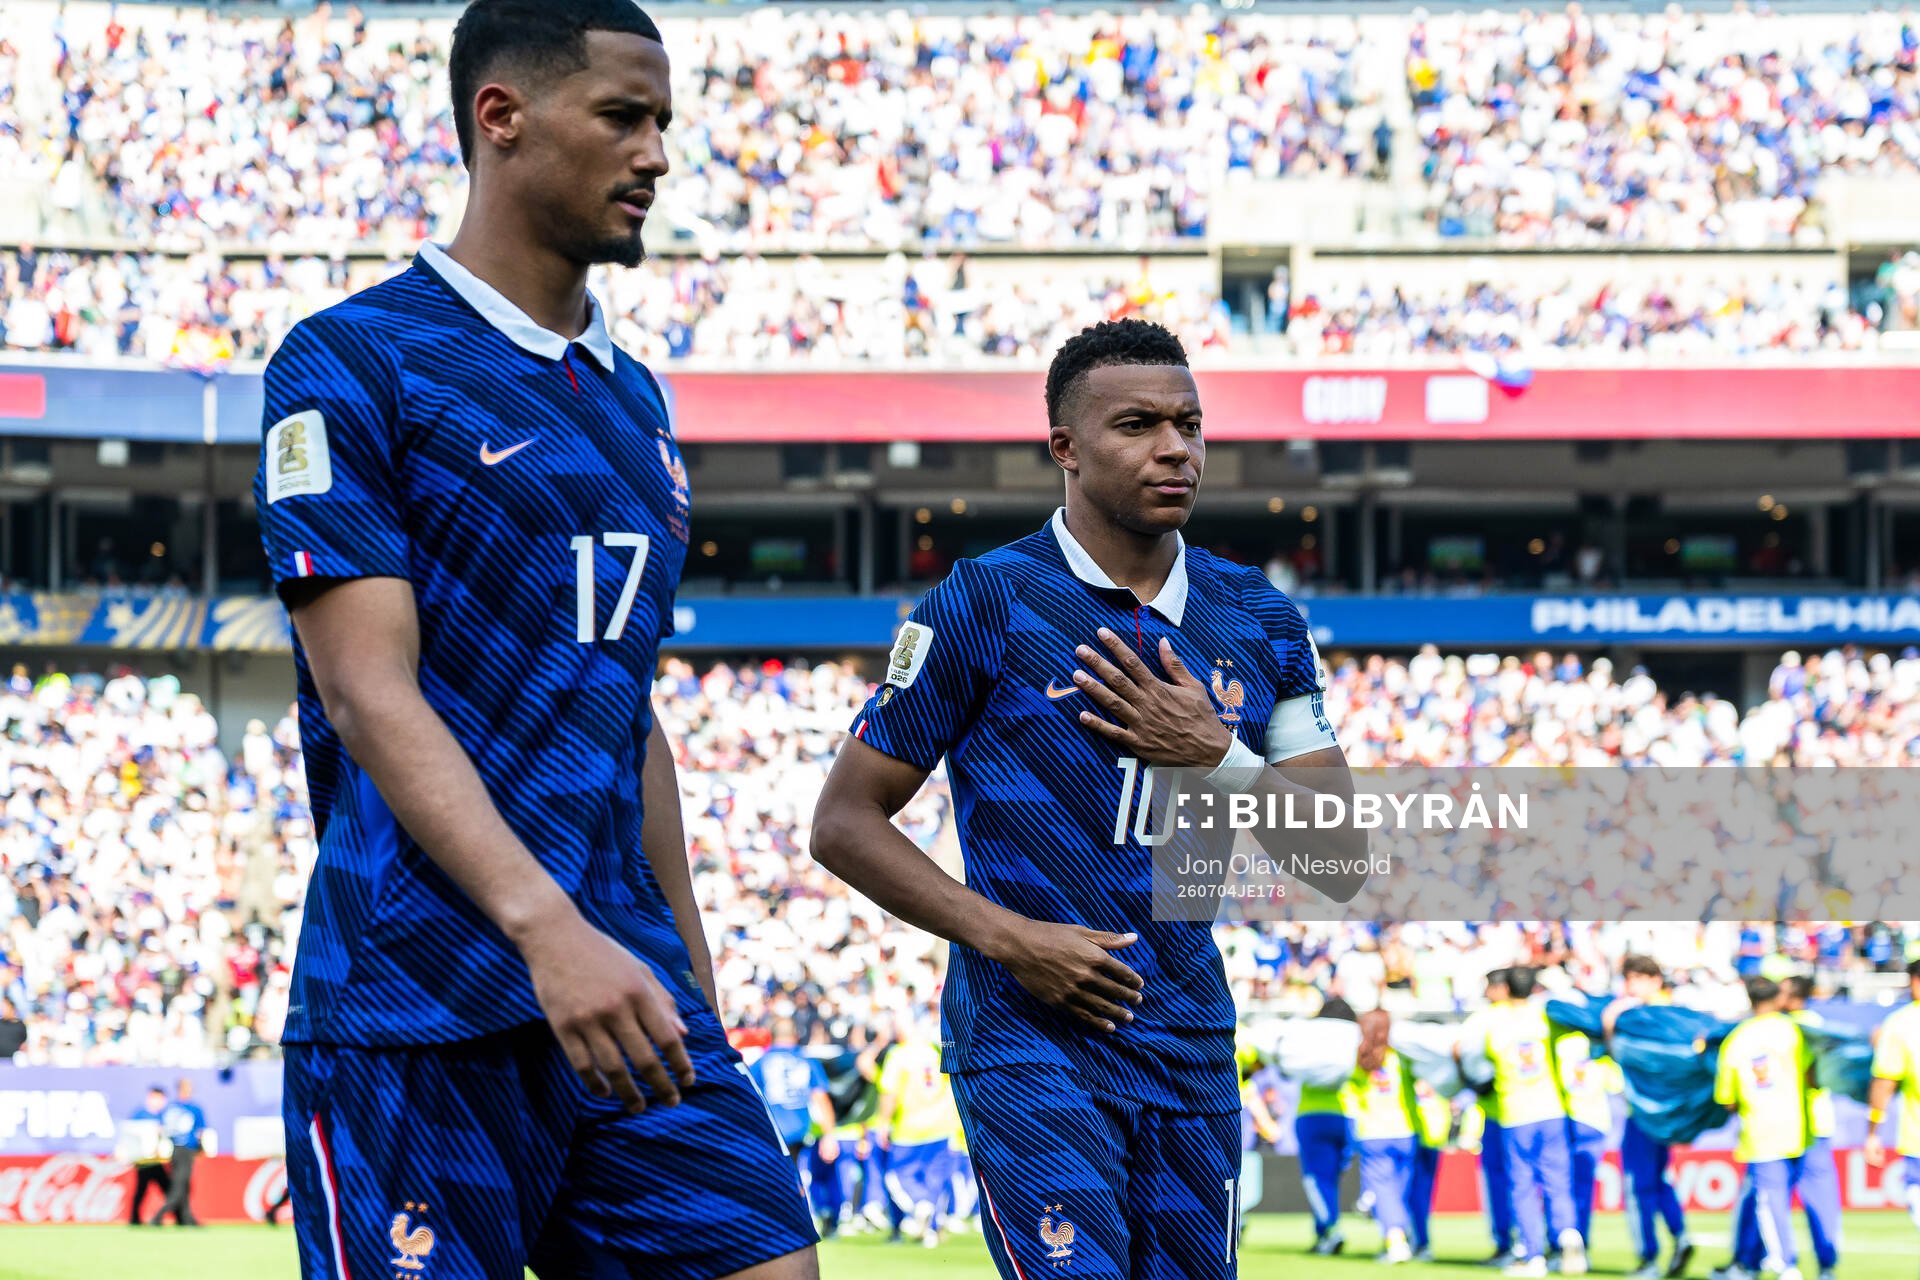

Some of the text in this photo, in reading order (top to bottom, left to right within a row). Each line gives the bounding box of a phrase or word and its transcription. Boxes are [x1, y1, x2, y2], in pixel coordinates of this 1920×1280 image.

[570, 532, 649, 643] 17
[1530, 597, 1920, 633] PHILADELPHIA
[1113, 757, 1183, 847] 10
[0, 1090, 114, 1138] FIFA
